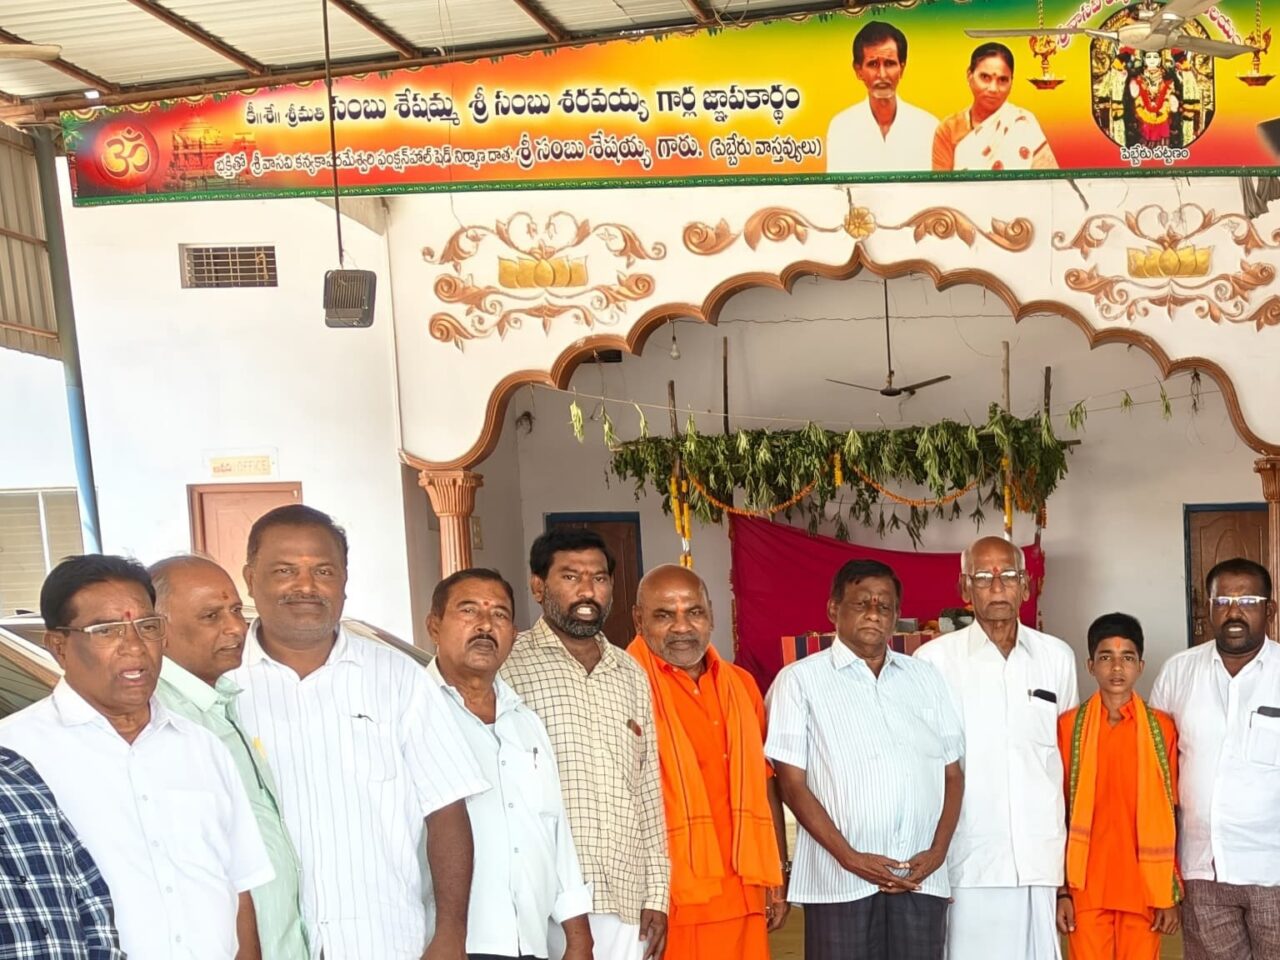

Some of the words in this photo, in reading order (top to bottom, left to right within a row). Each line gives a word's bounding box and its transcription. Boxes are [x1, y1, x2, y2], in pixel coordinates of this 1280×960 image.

[285, 103, 325, 127] శ్రీమతి
[331, 95, 387, 122] సంబు
[393, 88, 461, 126] శేషమ్మ
[468, 86, 489, 124] శ్రీ
[495, 90, 551, 116] సంబు
[454, 150, 486, 168] నిర్మాణ
[516, 133, 534, 168] శ్రీ
[536, 137, 584, 161] సంబు
[589, 131, 651, 168] శేషయ్య
